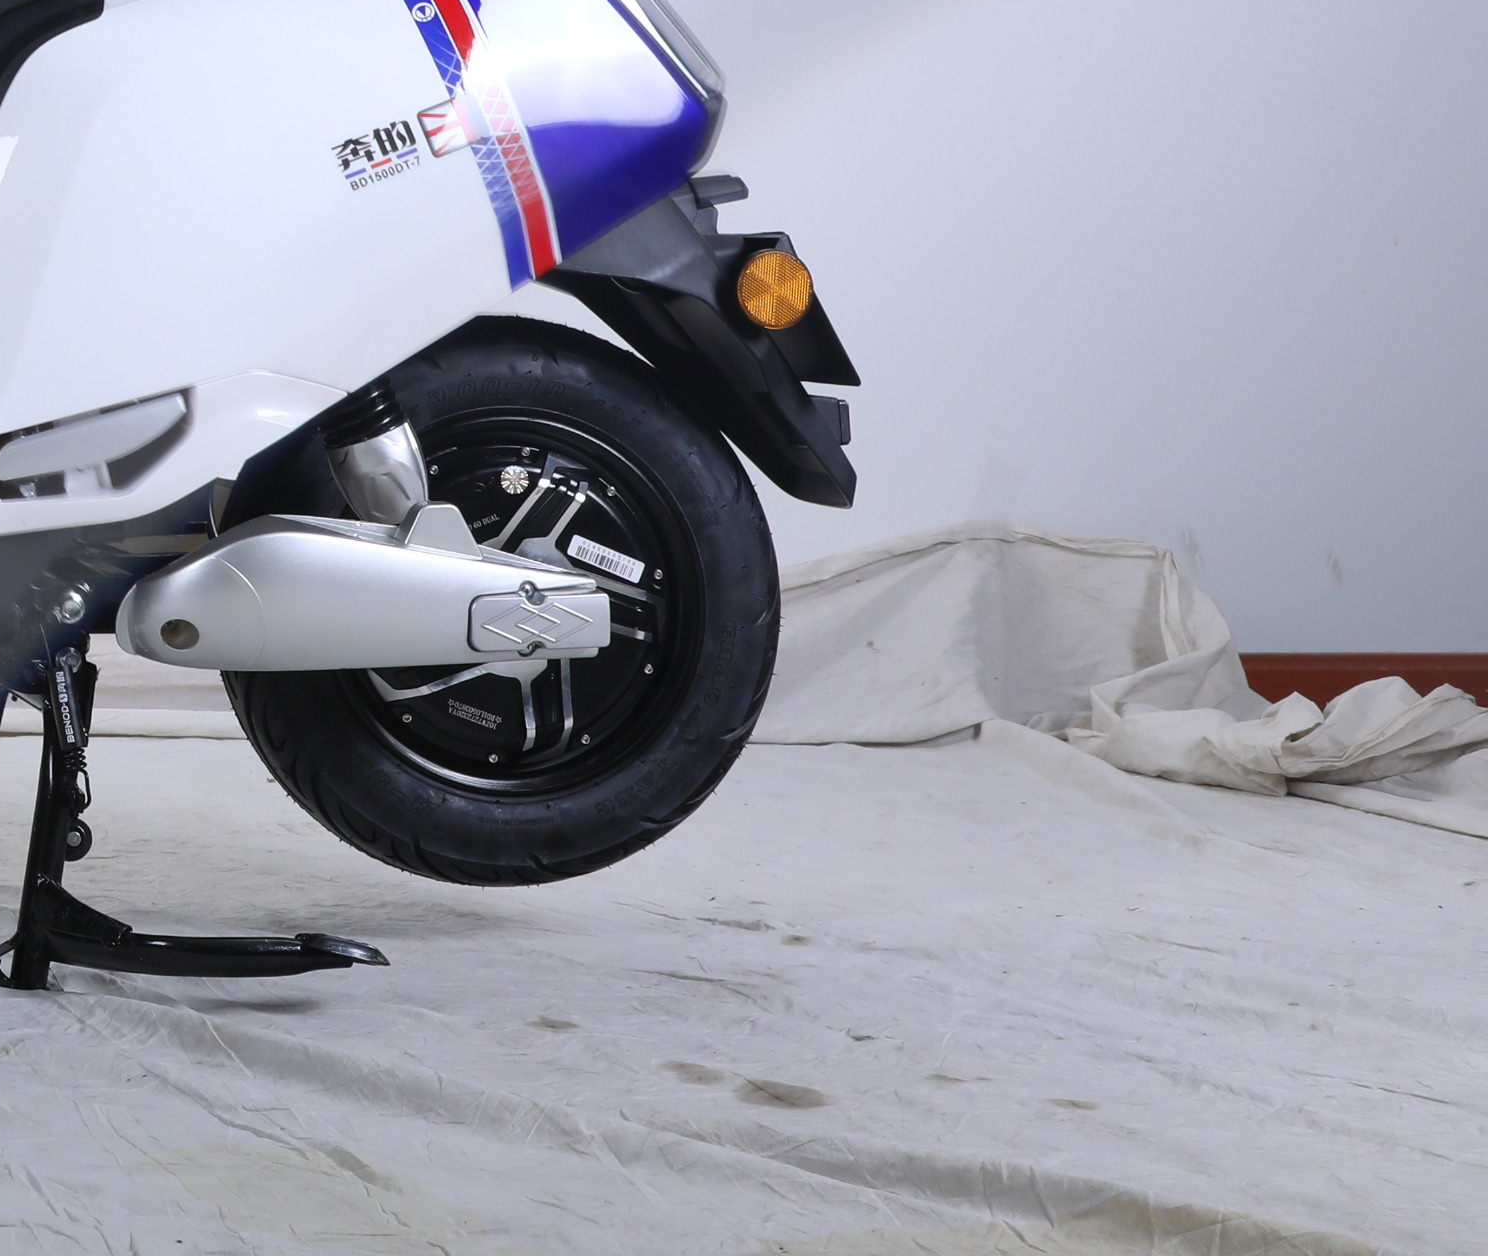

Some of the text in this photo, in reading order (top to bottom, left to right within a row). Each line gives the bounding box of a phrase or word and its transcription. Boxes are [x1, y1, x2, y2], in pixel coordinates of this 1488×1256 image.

[331, 120, 417, 172] 奔的
[349, 155, 422, 191] BD1500DT-7
[704, 618, 737, 707] CHAO
